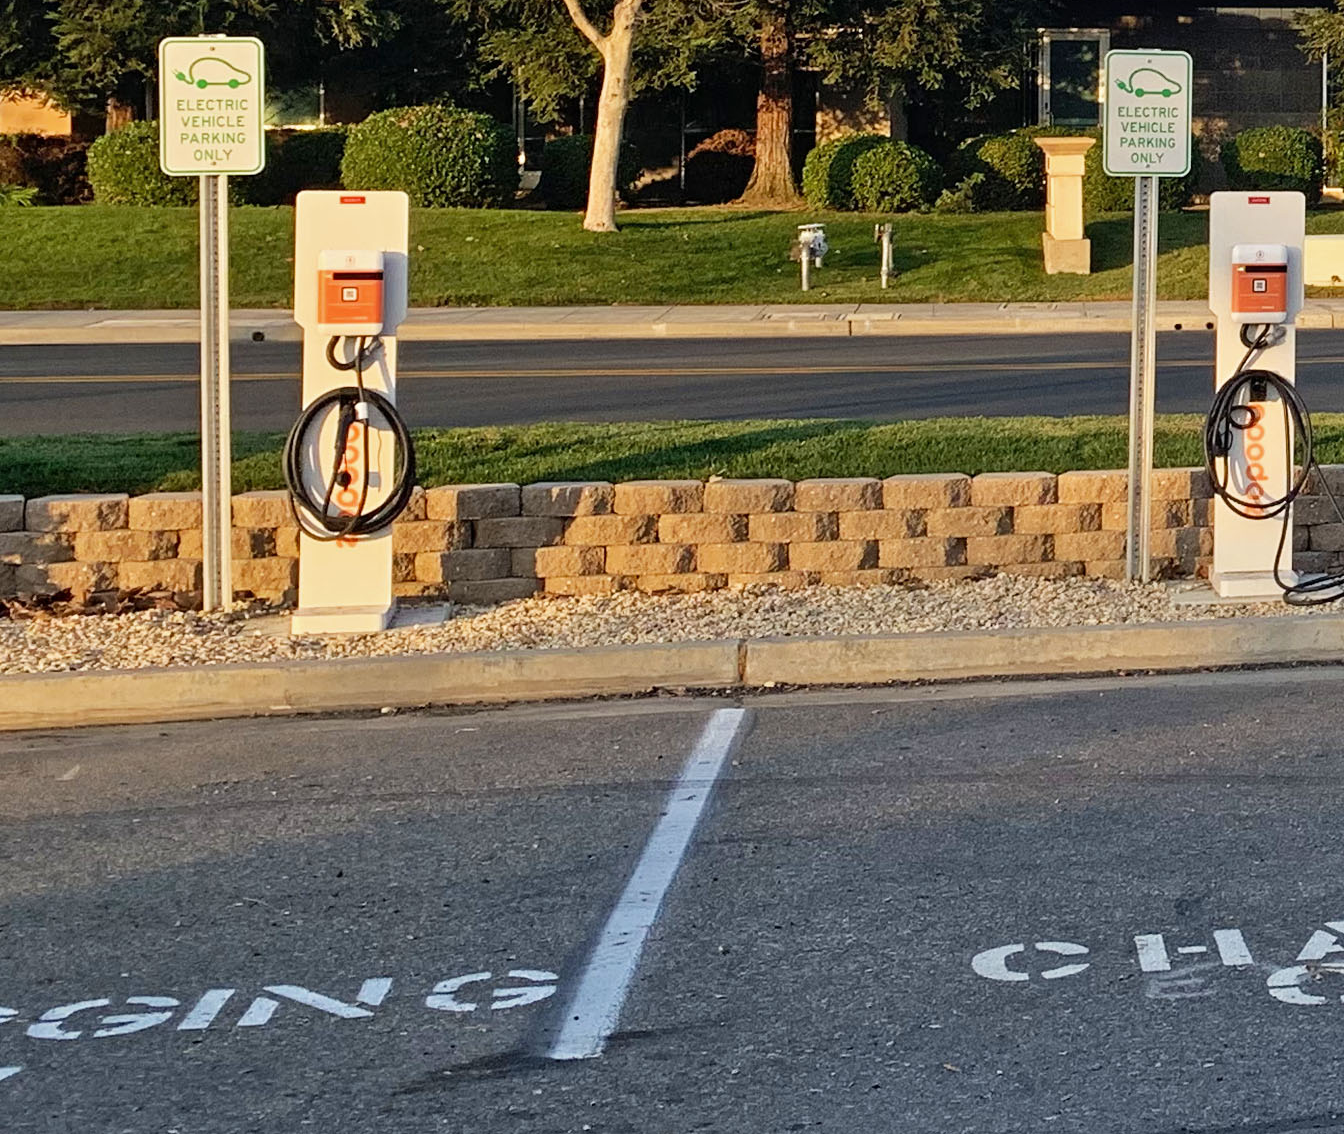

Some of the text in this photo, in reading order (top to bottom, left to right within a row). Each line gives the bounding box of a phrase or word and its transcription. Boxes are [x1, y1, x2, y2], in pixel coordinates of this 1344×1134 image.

[176, 99, 249, 111] ELECTRIC
[1117, 106, 1179, 118] ELECTRIC
[181, 115, 246, 128] VEHICLE
[1120, 121, 1176, 134] VEHICLE
[180, 132, 246, 144] PARKING
[1119, 137, 1176, 149] PARKING
[193, 149, 233, 161] ONLY
[1130, 152, 1165, 164] ONLY
